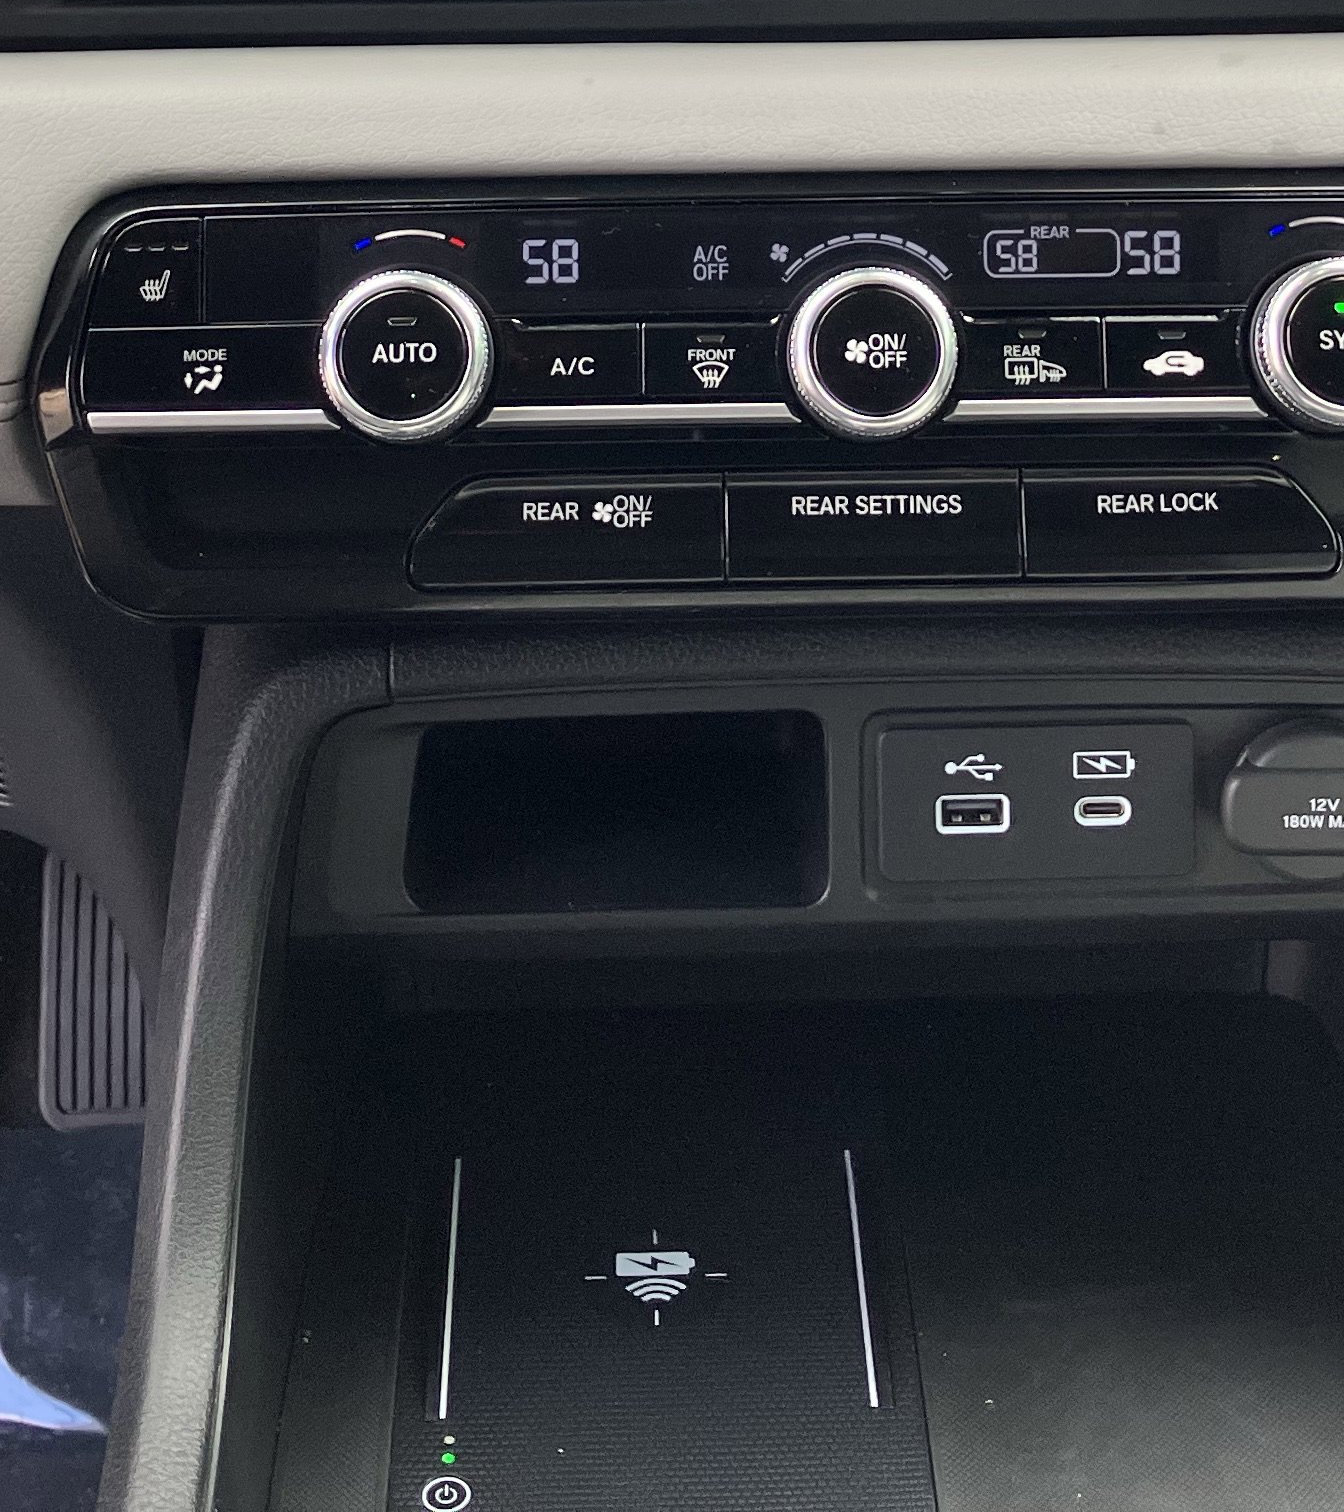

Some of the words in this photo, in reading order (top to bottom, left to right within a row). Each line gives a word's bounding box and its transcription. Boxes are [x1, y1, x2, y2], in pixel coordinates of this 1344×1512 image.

[1030, 225, 1070, 240] REAR
[522, 238, 579, 284] 58
[693, 244, 729, 262] A/C
[993, 239, 1040, 274] 58
[1123, 230, 1181, 275] 58
[693, 262, 730, 282] OFF
[868, 333, 907, 351] ON/
[1003, 344, 1041, 358] REAR
[183, 348, 228, 362] MODE
[371, 341, 437, 364] AUTO
[687, 348, 737, 363] FRONT
[868, 351, 908, 370] OFF
[550, 356, 595, 376] A/C
[522, 501, 579, 521] REAR
[613, 494, 653, 511] ON/
[791, 495, 850, 516] REAR
[855, 494, 963, 515] SETTINGS
[1097, 493, 1155, 514] REAR
[1159, 491, 1219, 513] LOCK
[613, 511, 654, 529] OFF
[1308, 797, 1341, 812] 12V
[1282, 814, 1325, 830] 180W
